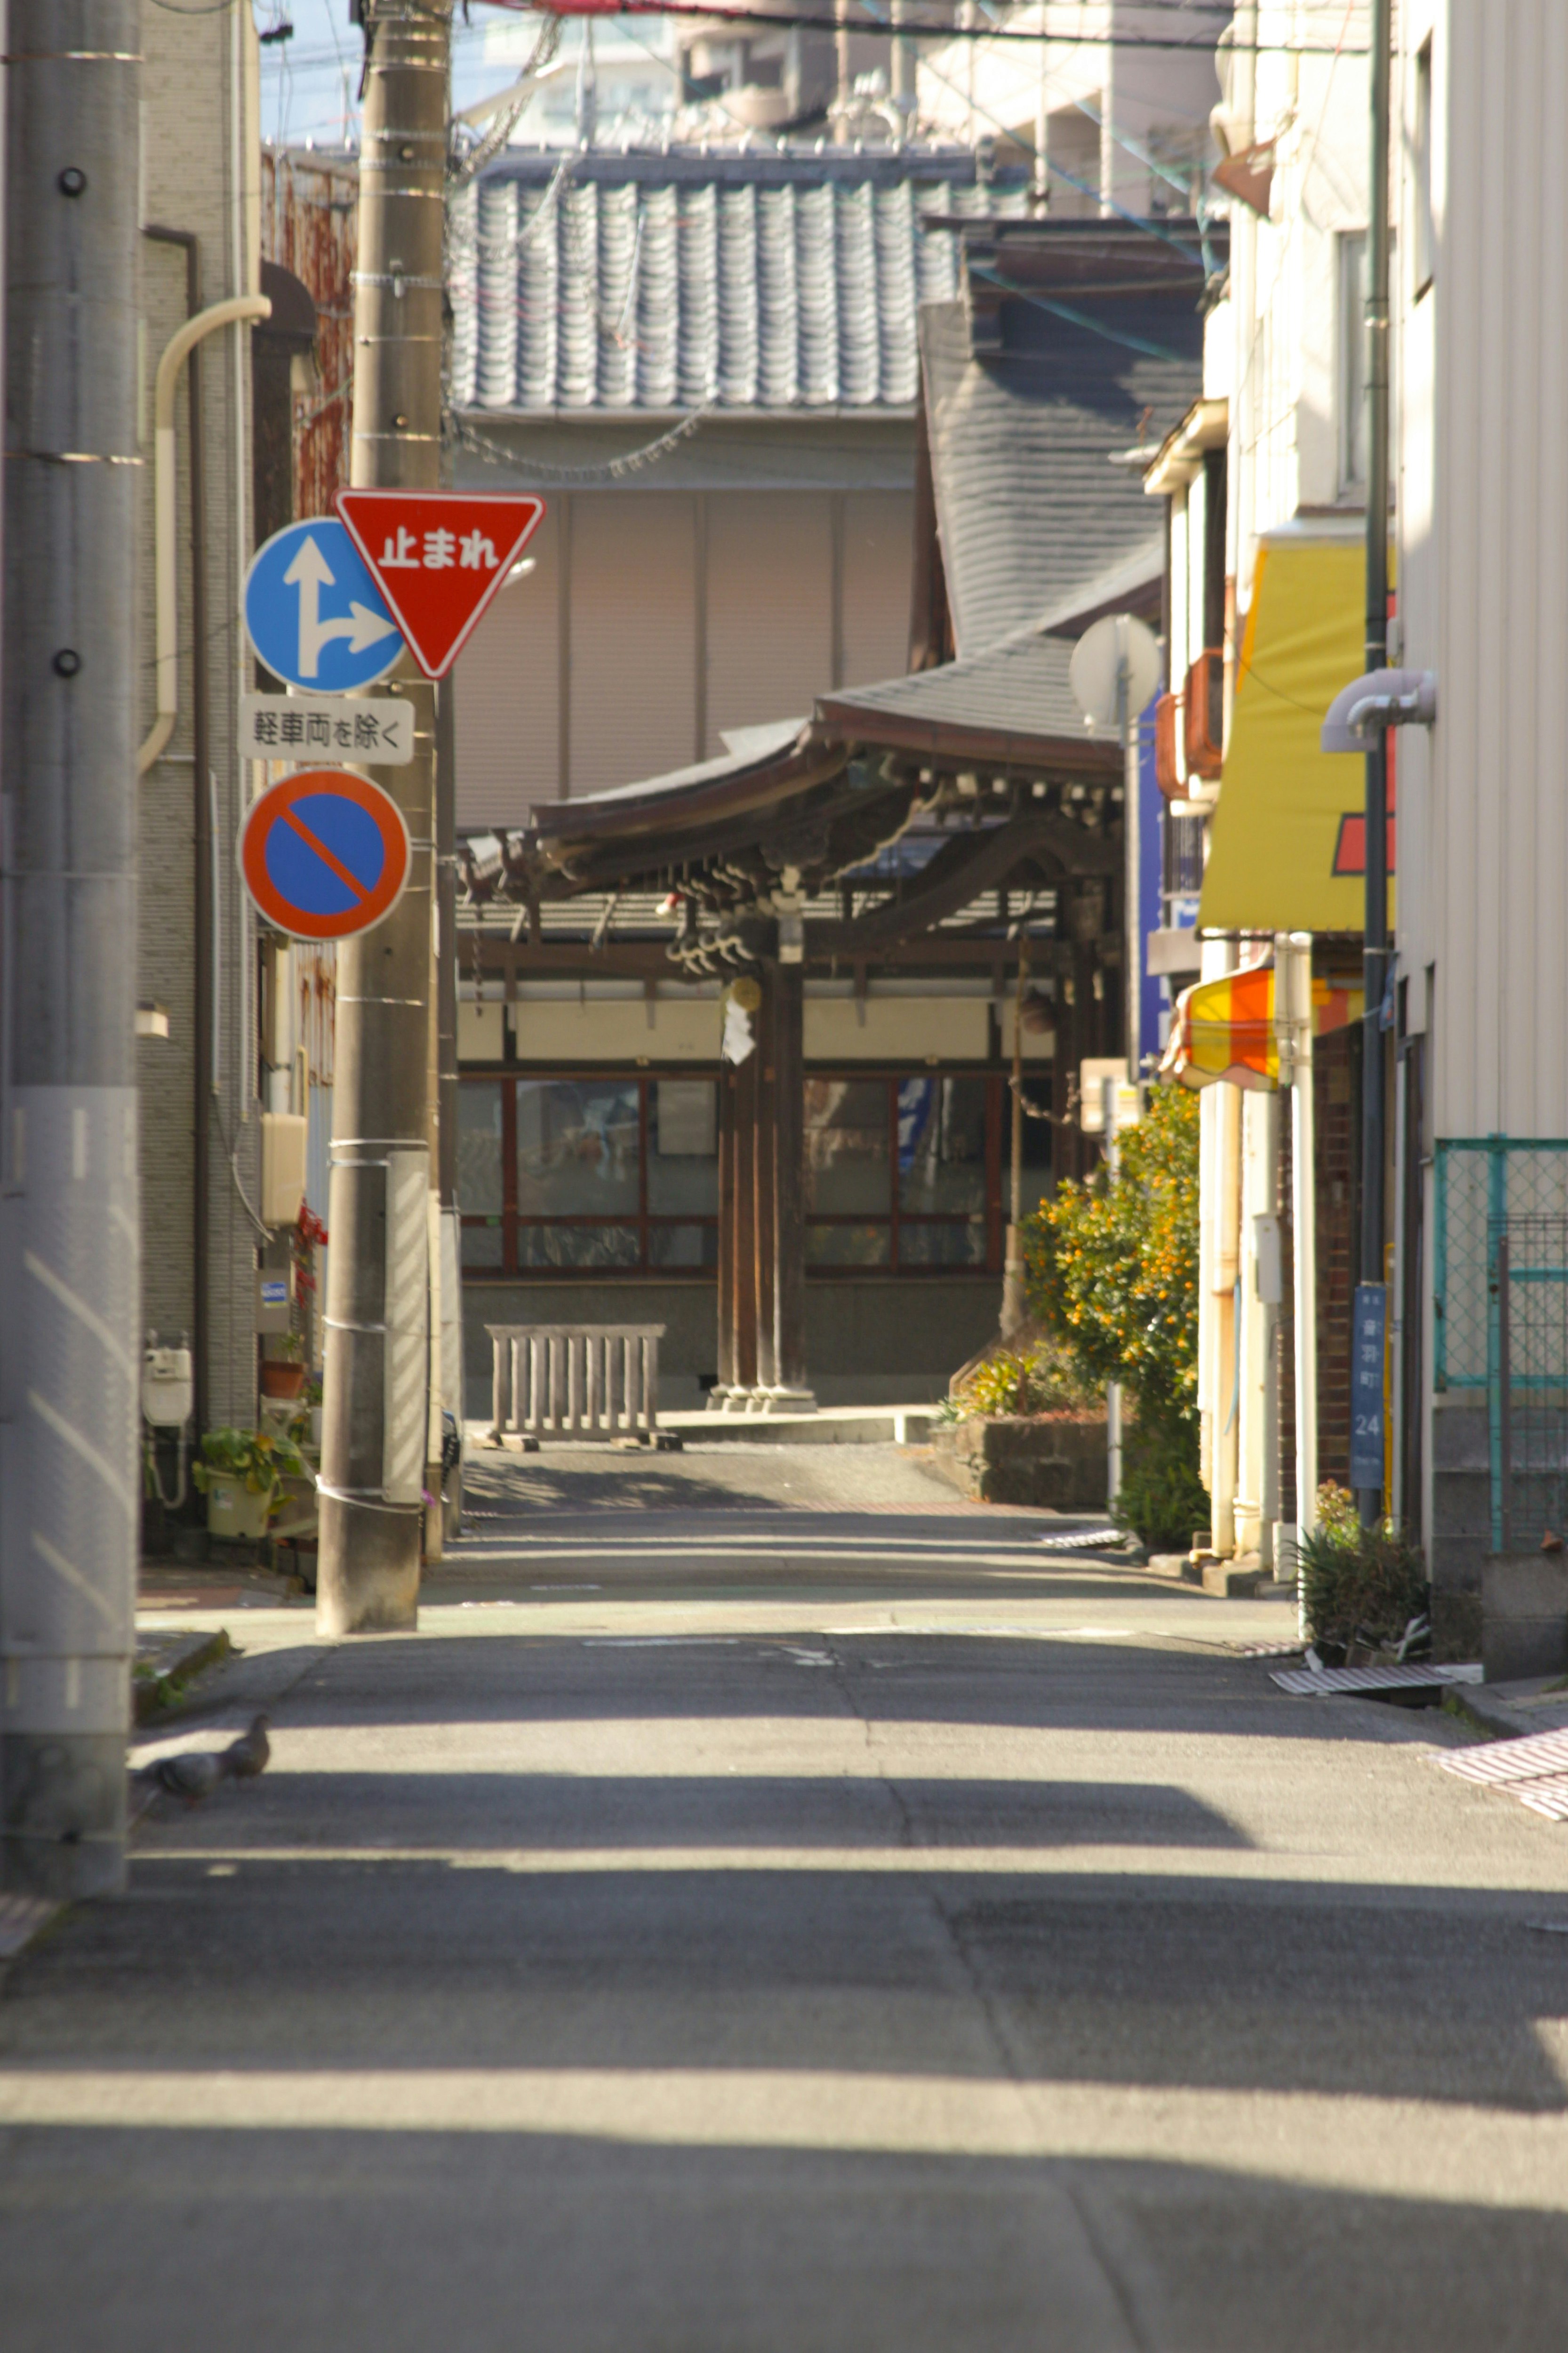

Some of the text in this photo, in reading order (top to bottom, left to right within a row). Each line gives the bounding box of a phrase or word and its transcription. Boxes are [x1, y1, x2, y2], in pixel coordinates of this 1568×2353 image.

[378, 525, 499, 570] 止まれ
[254, 710, 399, 749] 軽車両を除く
[1355, 1414, 1380, 1435] 24
